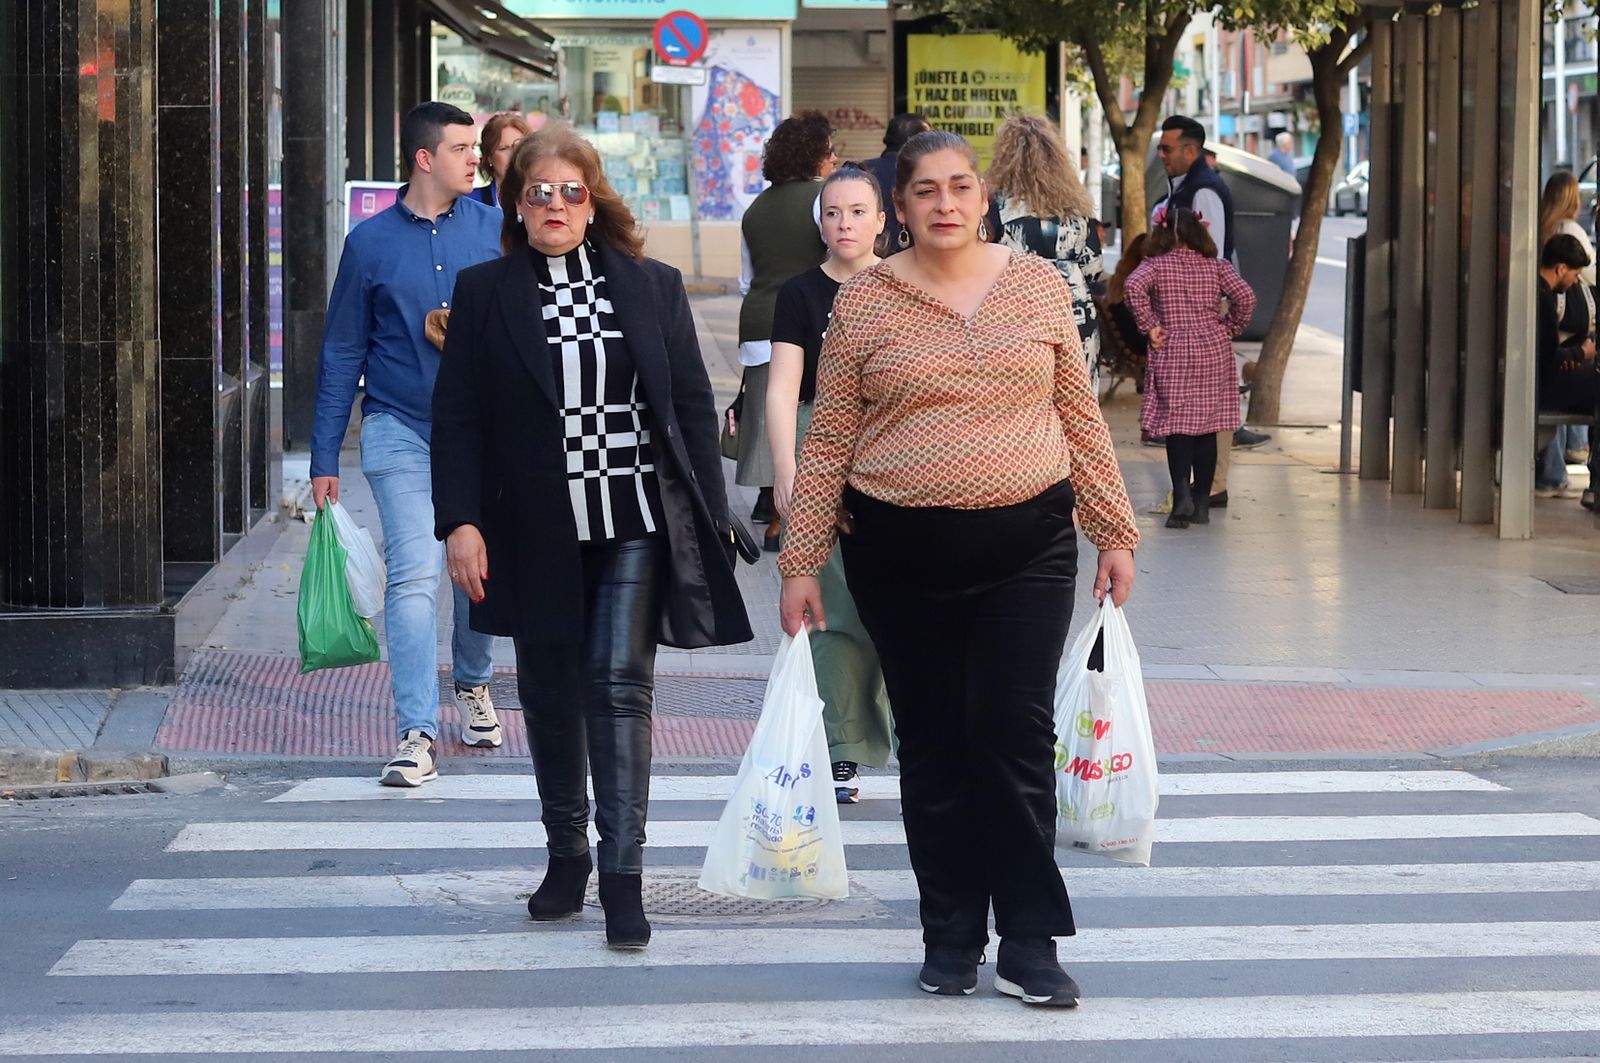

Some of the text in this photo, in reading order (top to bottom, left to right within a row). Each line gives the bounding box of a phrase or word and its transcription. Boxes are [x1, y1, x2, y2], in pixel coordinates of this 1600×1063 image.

[915, 69, 957, 85] ¡ÚNETE
[960, 71, 969, 84] A
[915, 88, 1018, 102] Y HAZ DE HUELVA
[916, 105, 940, 118] UNA
[944, 106, 992, 119] CIUDAD
[932, 123, 994, 136] STENIBLE!
[764, 762, 812, 790] Ars
